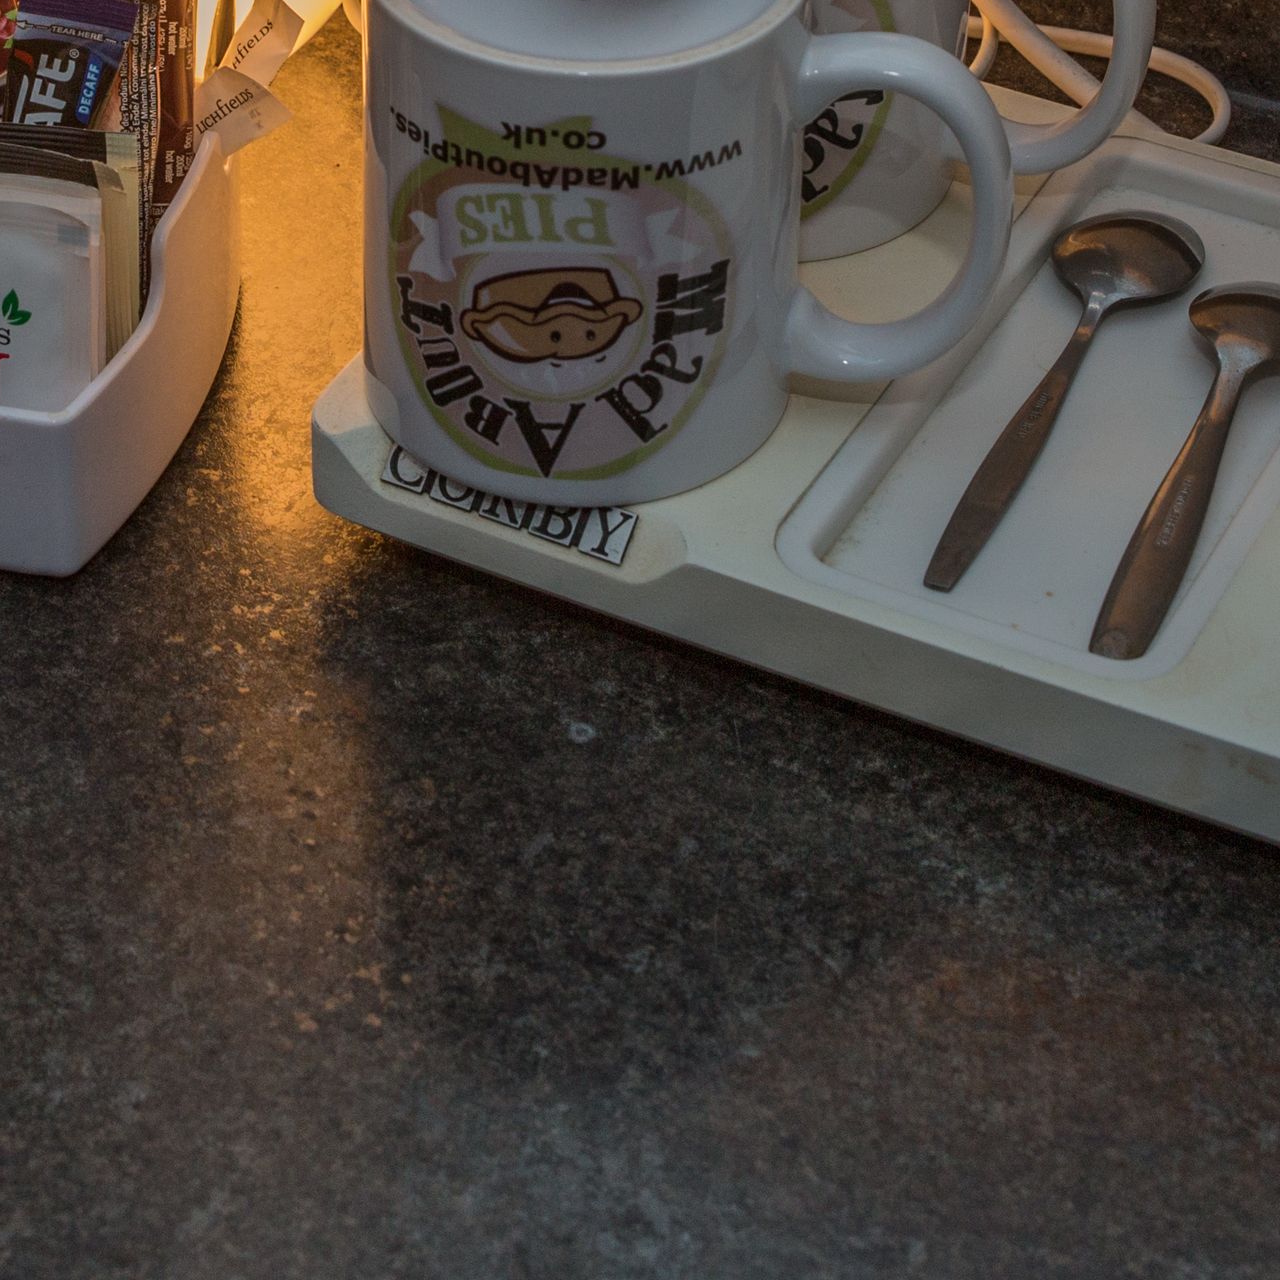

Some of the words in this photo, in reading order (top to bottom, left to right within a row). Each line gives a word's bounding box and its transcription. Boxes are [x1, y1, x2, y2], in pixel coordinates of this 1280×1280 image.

[51, 25, 74, 36] TEAR
[76, 30, 103, 41] HERE
[168, 21, 177, 34] hot
[167, 35, 176, 55] water
[78, 63, 101, 114] DECAFF
[120, 78, 128, 110] Produits
[120, 113, 129, 126] des
[132, 102, 140, 125] Ende/
[501, 119, 607, 152] co.uk
[165, 149, 174, 162] hot
[164, 163, 173, 183] water
[454, 193, 614, 248] PIES
[595, 258, 731, 444] Mad
